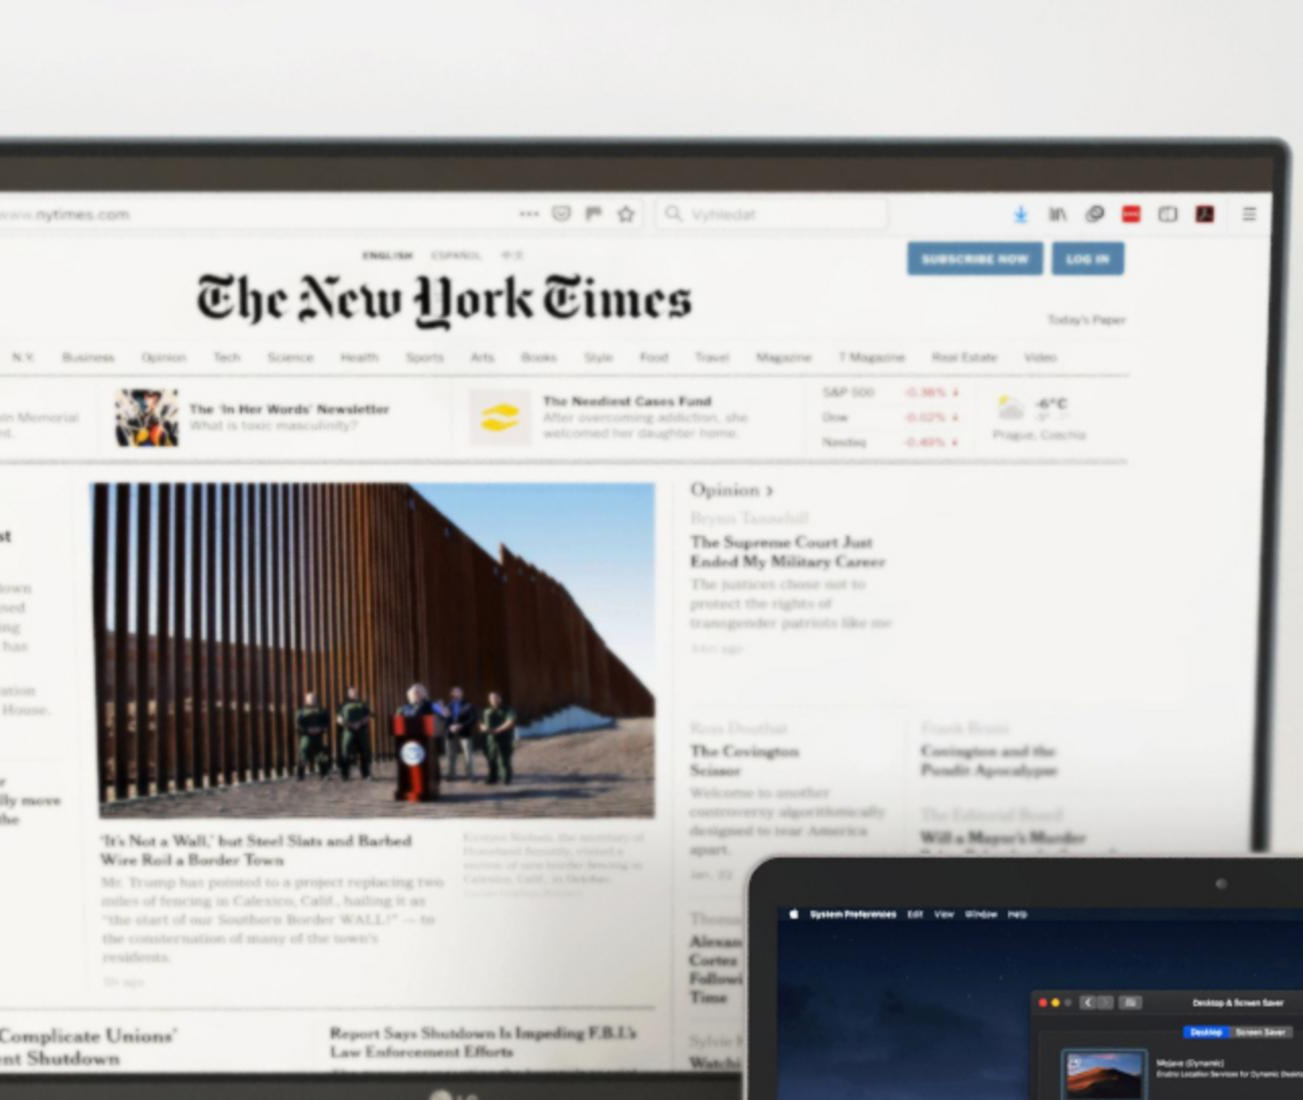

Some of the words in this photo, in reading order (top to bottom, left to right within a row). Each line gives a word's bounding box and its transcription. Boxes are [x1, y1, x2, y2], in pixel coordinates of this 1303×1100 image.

[922, 254, 994, 264] SUBSCRIBE
[998, 254, 1028, 264] NOW
[1066, 254, 1092, 265] LOG
[1095, 254, 1110, 264] IN
[198, 274, 287, 324] The
[298, 275, 401, 322] New
[414, 276, 533, 331] York
[544, 274, 691, 319] Times
[690, 482, 760, 500] Opinion
[691, 535, 720, 548] The
[723, 536, 791, 551] Supreme
[794, 535, 839, 549] Court
[843, 535, 873, 549] Just
[690, 555, 739, 568] Ended
[743, 554, 766, 570] My
[771, 555, 831, 568] Military
[834, 555, 885, 568] Career
[105, 1028, 176, 1043] Unions'
[330, 1027, 379, 1041] Report
[384, 1027, 417, 1041] Says
[420, 1026, 497, 1041] Shutdown
[513, 1025, 586, 1043] Impeding
[587, 1025, 639, 1041] F.B.I.'s
[27, 1050, 120, 1066] Shutdown
[330, 1046, 361, 1058] Law
[365, 1045, 461, 1058] Enforcement
[463, 1044, 515, 1058] Efforts
